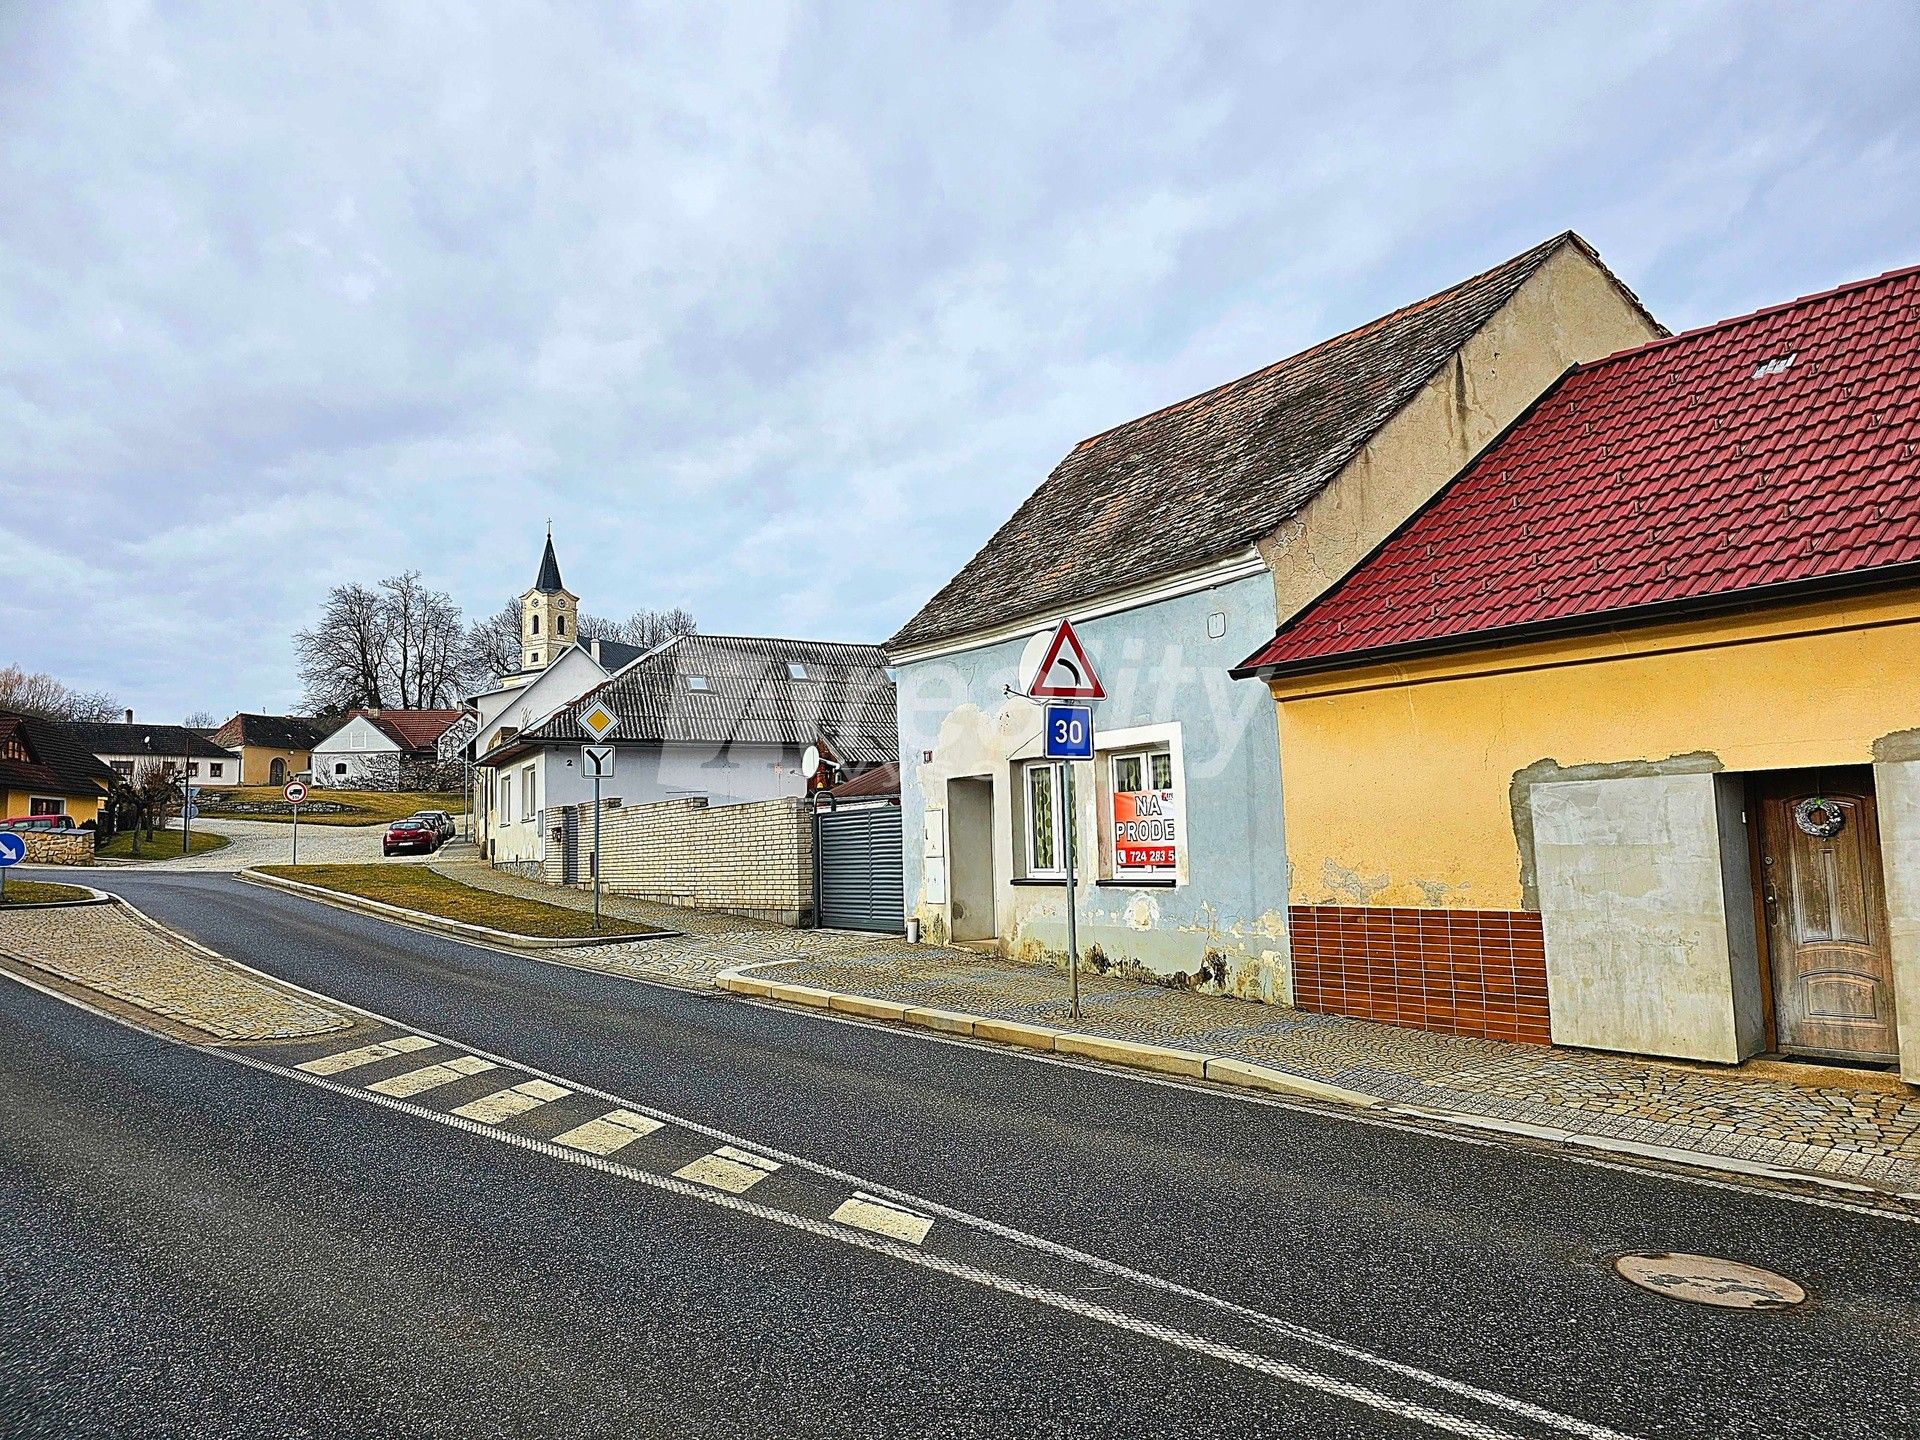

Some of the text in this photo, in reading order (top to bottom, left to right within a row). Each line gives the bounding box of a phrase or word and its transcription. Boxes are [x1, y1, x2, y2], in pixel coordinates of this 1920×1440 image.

[1055, 719, 1083, 744] 30
[566, 759, 573, 767] 2
[1134, 794, 1163, 817] NA
[1115, 818, 1175, 842] PRODE
[1129, 850, 1147, 863] 724
[1149, 849, 1166, 862] 283
